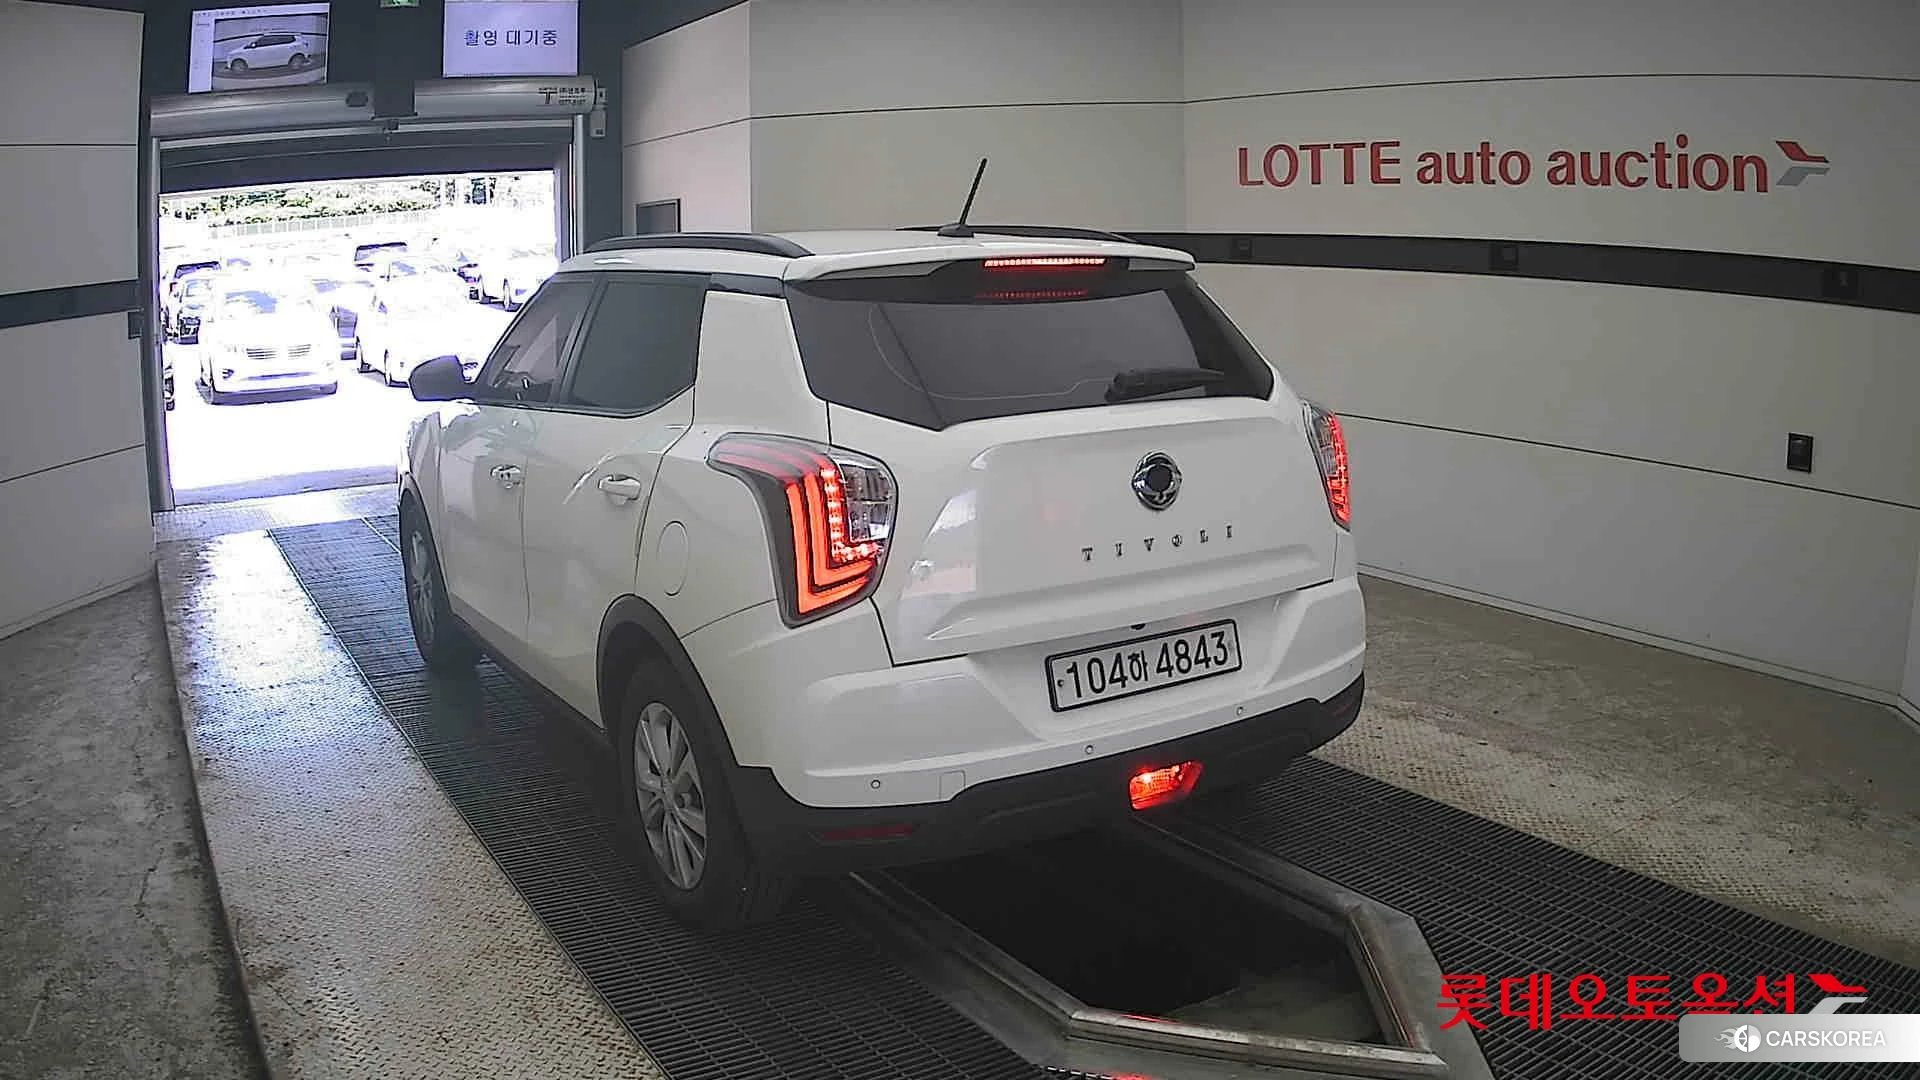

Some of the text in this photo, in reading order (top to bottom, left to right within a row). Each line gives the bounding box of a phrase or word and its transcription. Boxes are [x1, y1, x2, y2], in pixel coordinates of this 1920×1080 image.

[506, 29, 558, 46] 대기중
[1238, 133, 1769, 193] LOTTE auto auction
[1081, 524, 1234, 561] TIVOLI
[1066, 630, 1229, 699] 104하 4843
